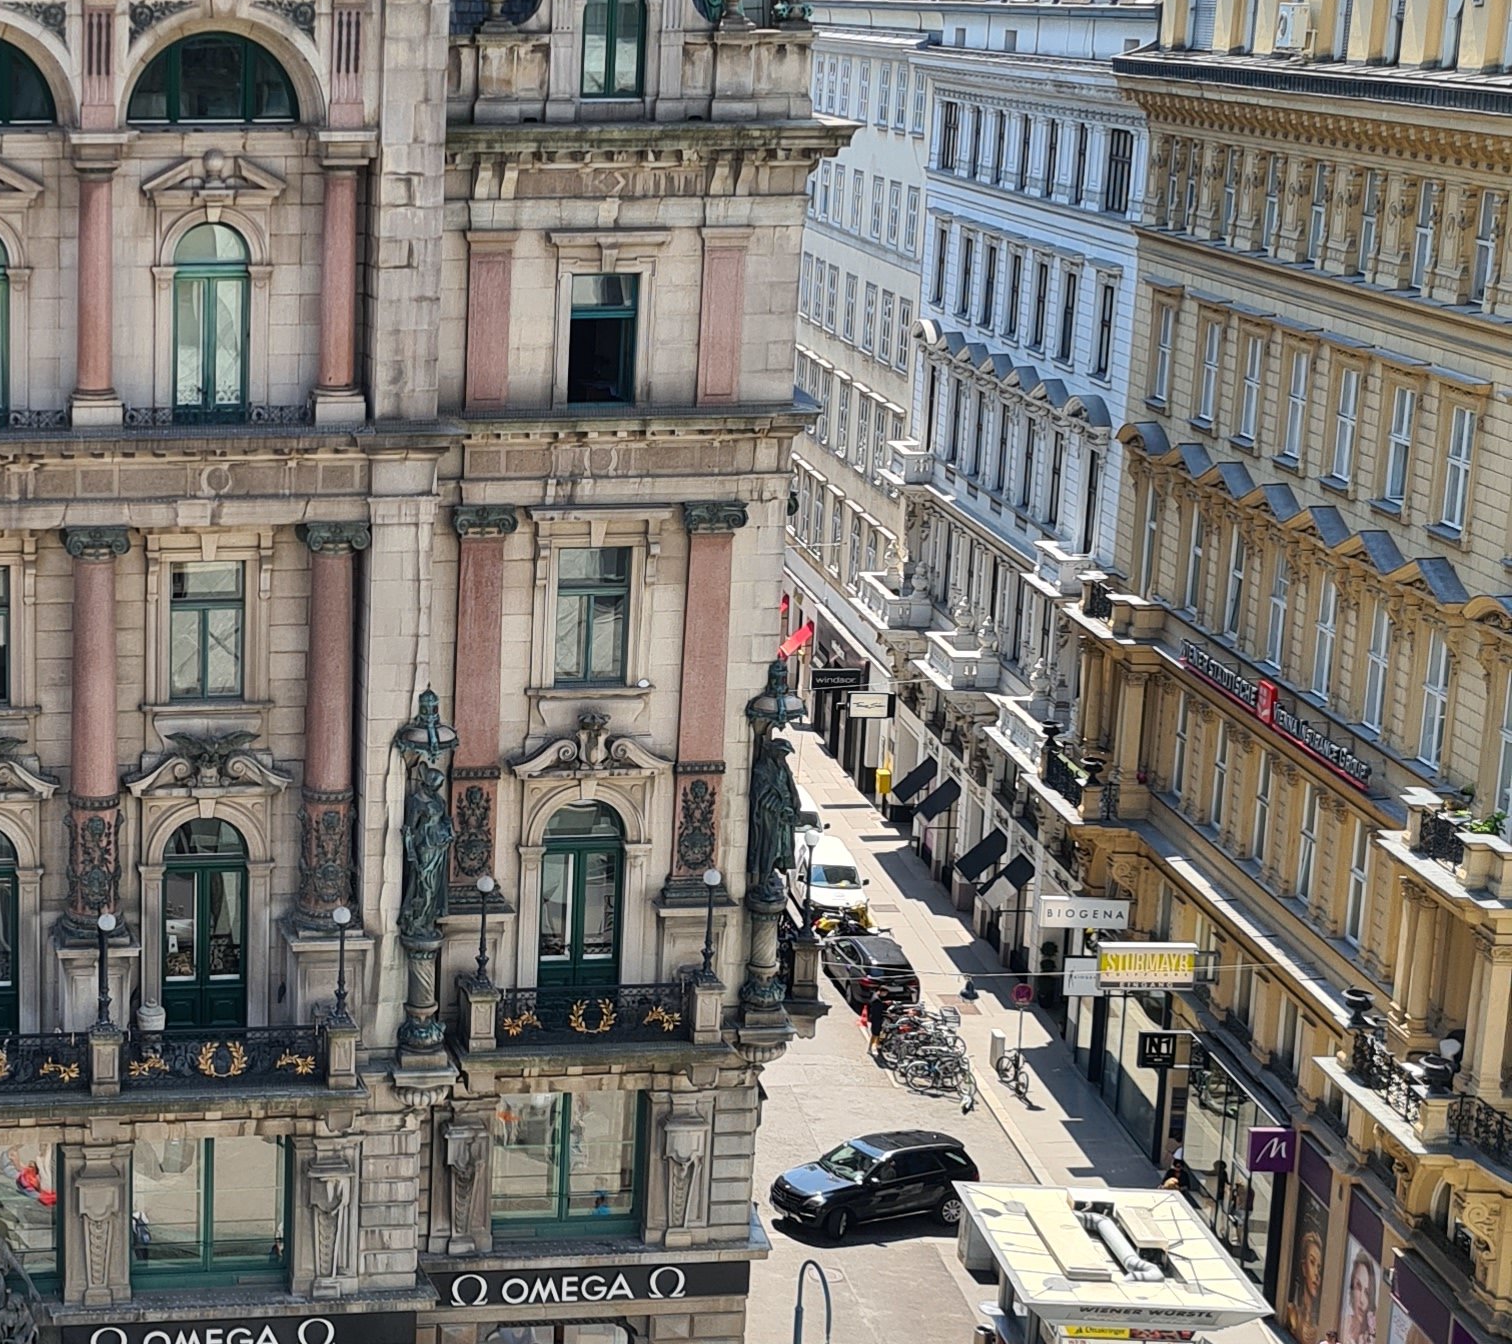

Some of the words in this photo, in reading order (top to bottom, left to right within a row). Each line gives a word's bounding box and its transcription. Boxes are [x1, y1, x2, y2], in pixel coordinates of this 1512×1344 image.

[1047, 908, 1124, 920] BIOGENA
[501, 1272, 635, 1304] OMEGA
[1079, 1306, 1143, 1315] WIENER
